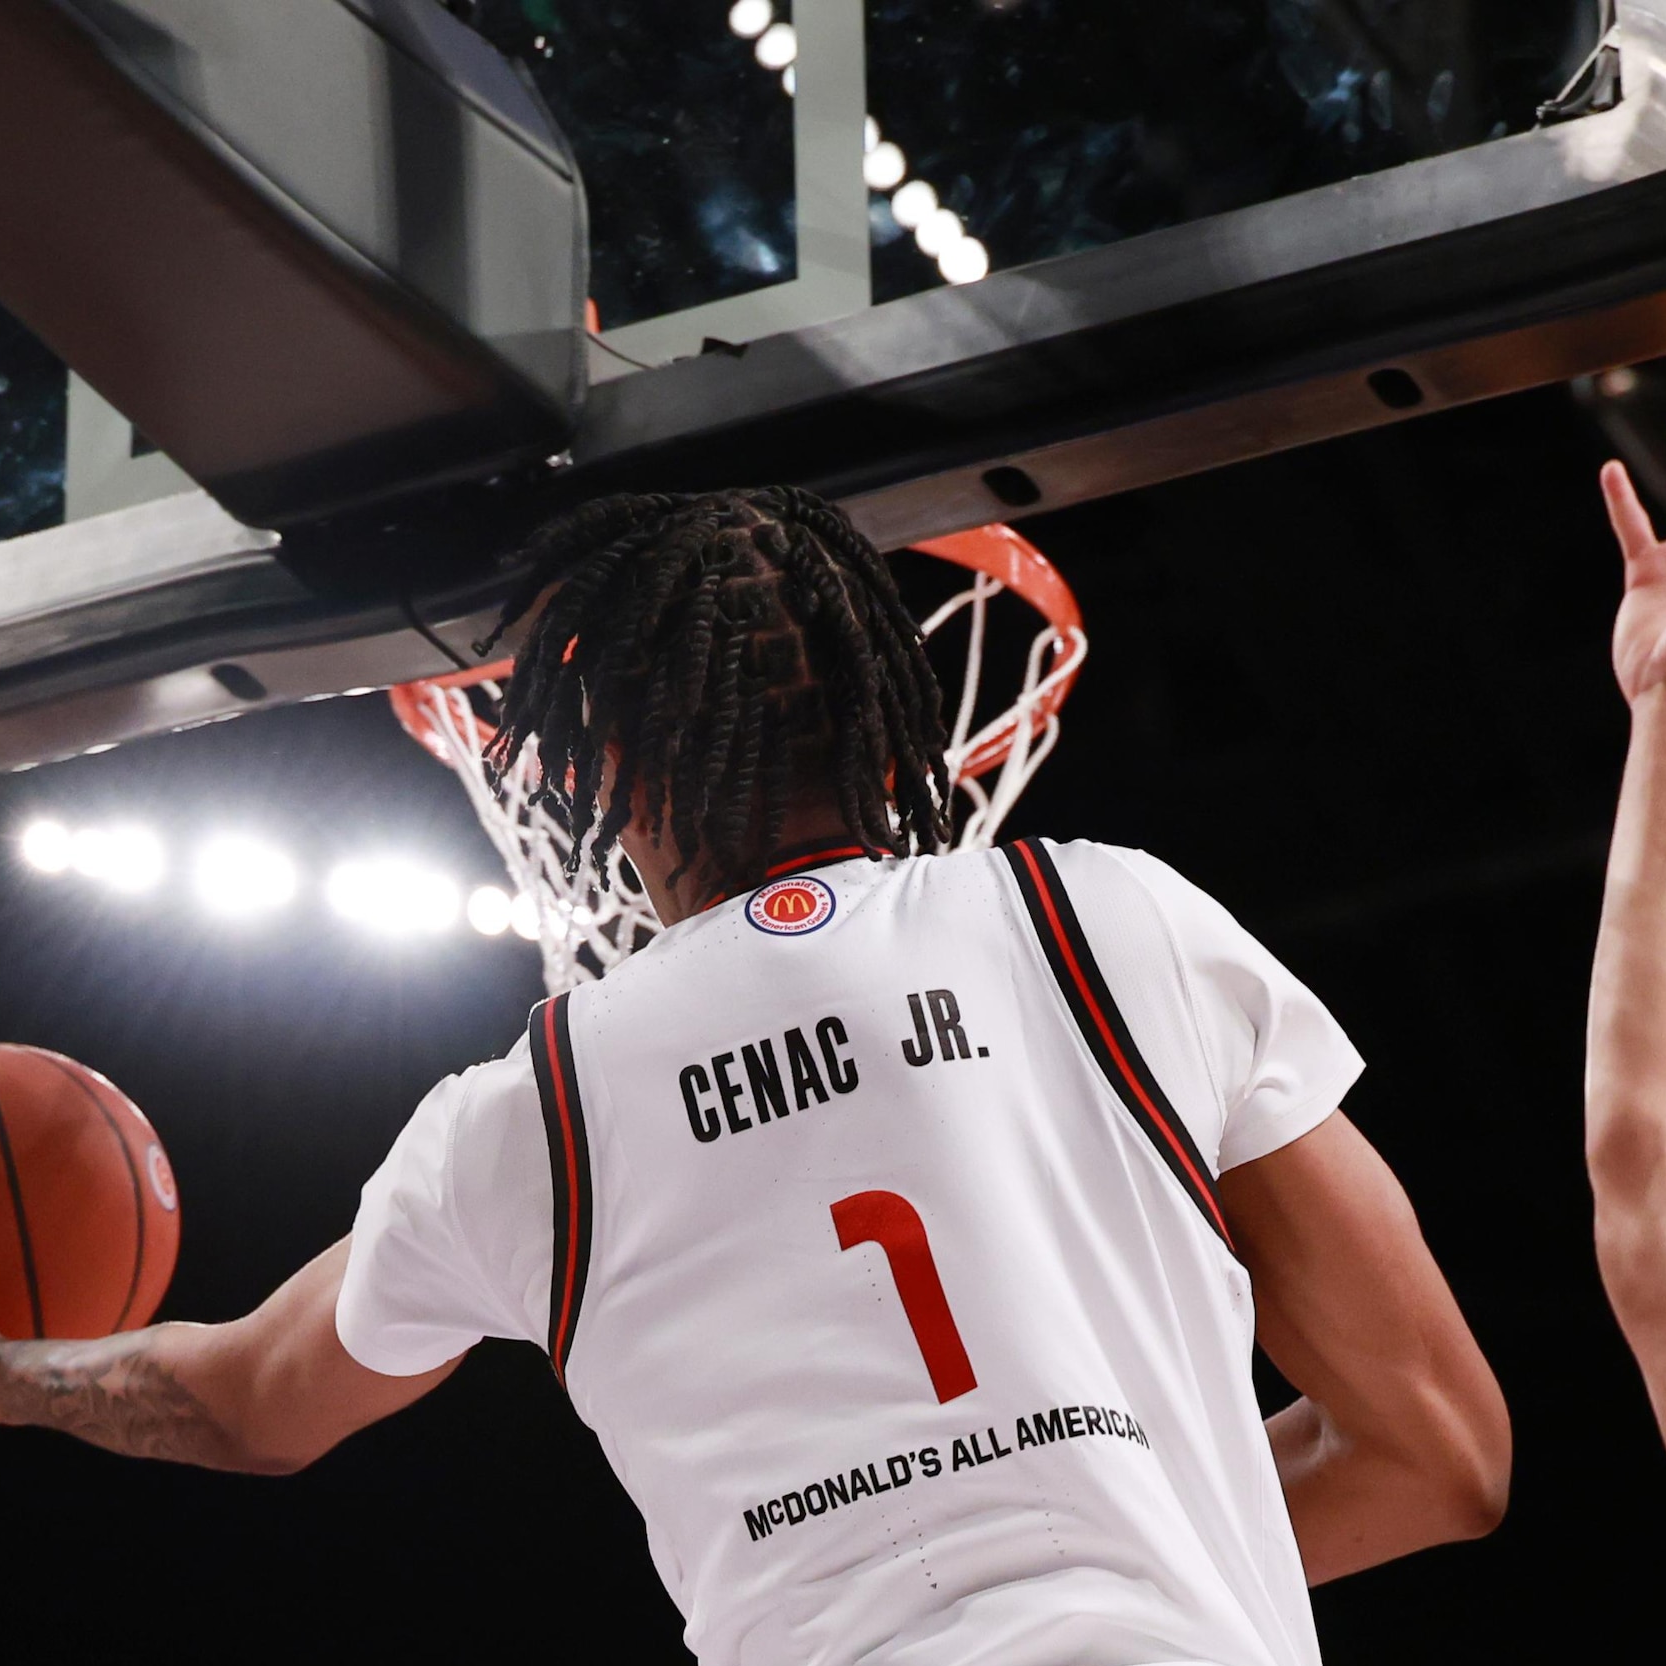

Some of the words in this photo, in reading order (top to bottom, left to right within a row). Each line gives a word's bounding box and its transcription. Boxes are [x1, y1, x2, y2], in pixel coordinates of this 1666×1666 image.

[758, 880, 818, 899] McDonald's
[760, 919, 807, 931] American
[806, 901, 829, 926] Games
[678, 1016, 860, 1144] CENAC
[900, 988, 990, 1067] JR.
[830, 1190, 978, 1405] 1
[951, 1427, 1012, 1472] ALL
[1016, 1406, 1150, 1450] AMERICAN
